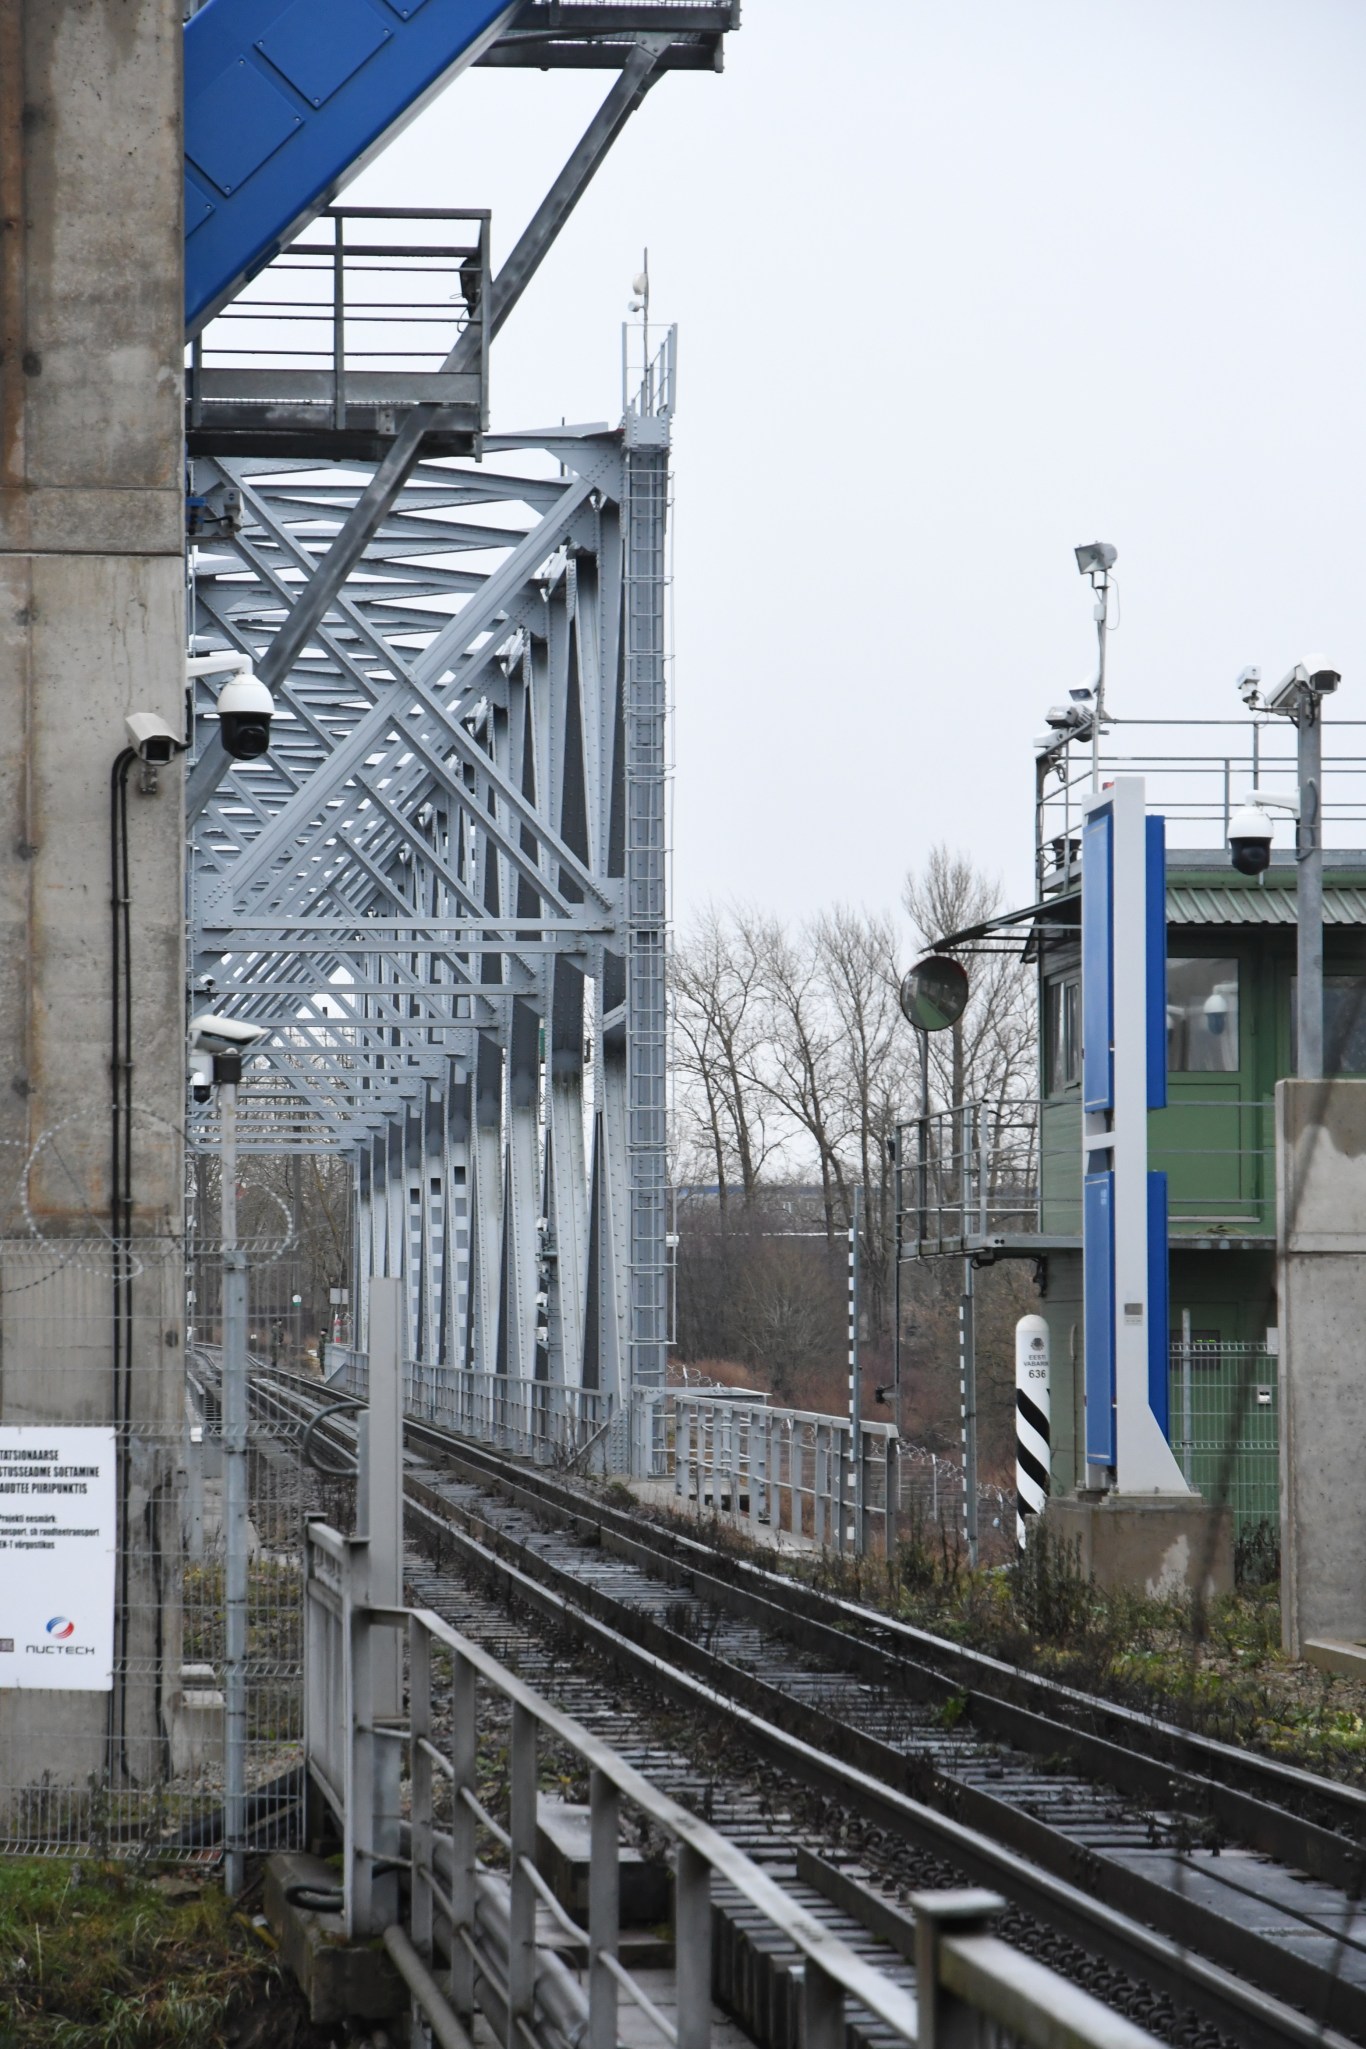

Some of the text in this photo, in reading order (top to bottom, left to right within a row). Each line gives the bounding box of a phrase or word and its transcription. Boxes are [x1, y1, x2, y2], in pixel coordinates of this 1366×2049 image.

[1029, 1369, 1046, 1378] 636
[53, 1466, 100, 1478] SOETAMINE
[31, 1482, 88, 1494] PIIRIPUNKTIS
[26, 1645, 95, 1655] NUCTECH
